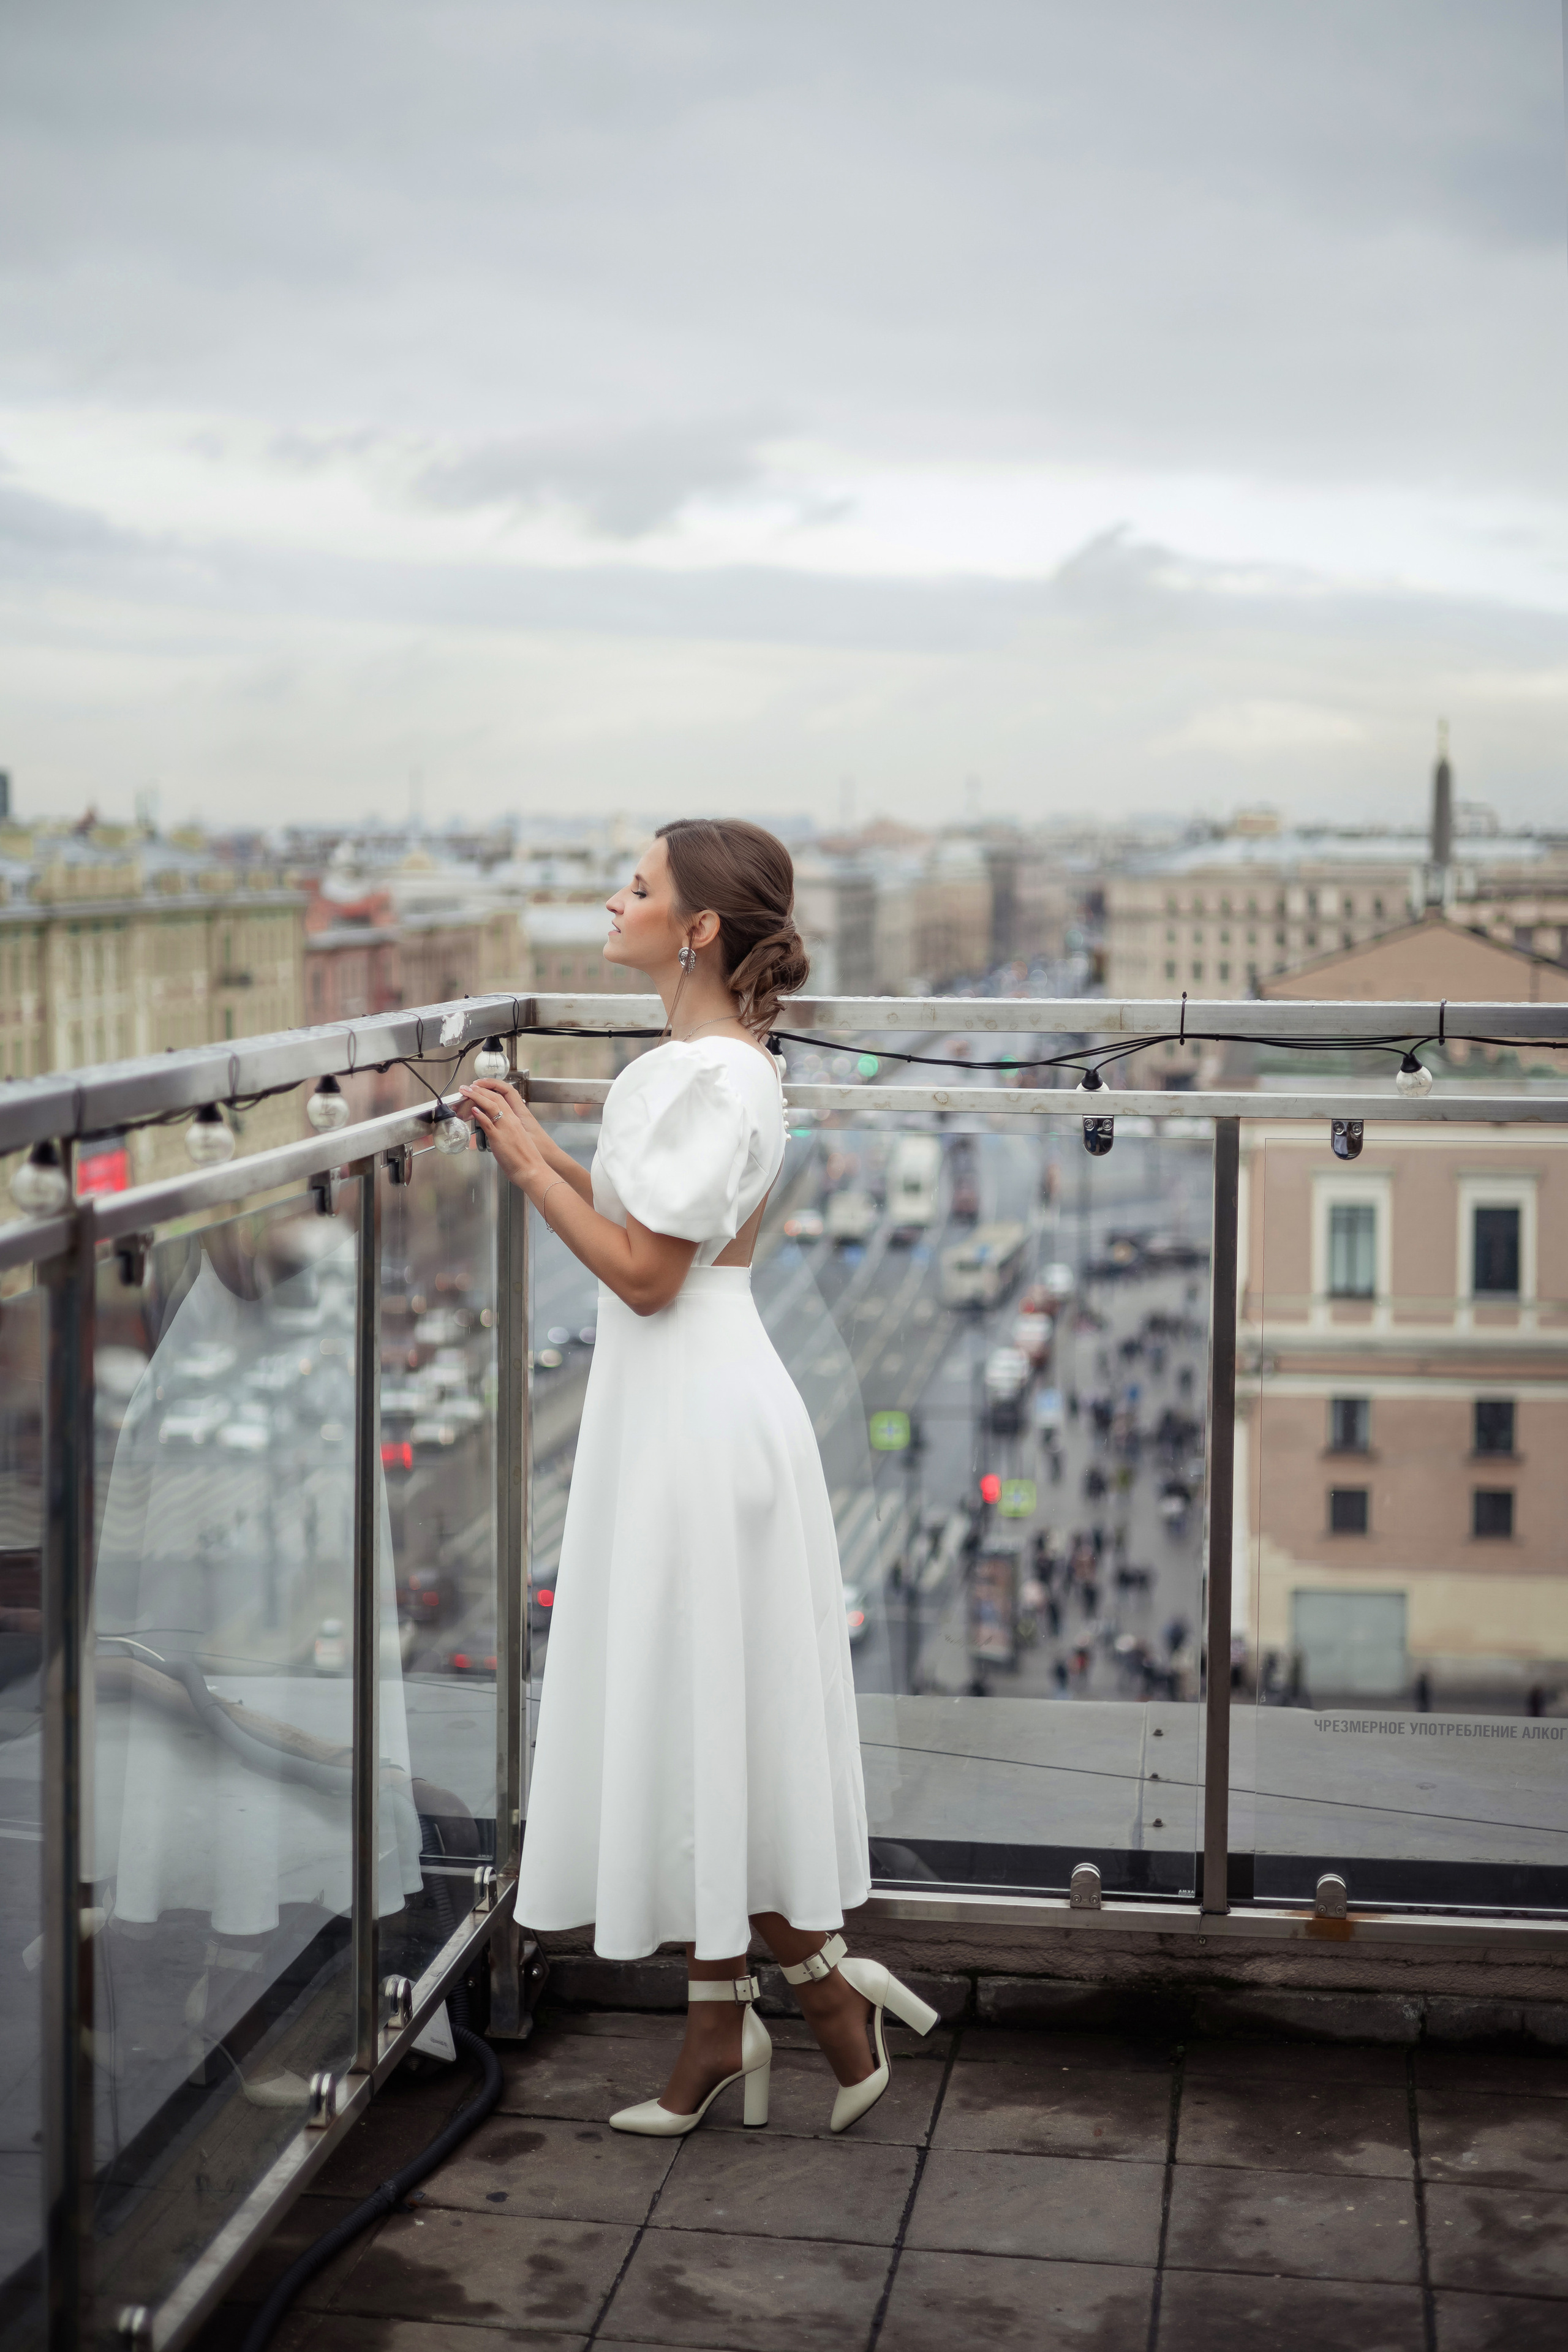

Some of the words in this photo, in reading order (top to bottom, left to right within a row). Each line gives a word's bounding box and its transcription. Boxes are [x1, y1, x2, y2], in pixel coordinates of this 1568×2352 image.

[1314, 1719, 1405, 1735] ЧРЕЗМЕРНОЕ
[1410, 1722, 1517, 1738] УПОТРЕБЛЕНИЕ
[1521, 1727, 1567, 1740] АЛКОГ
